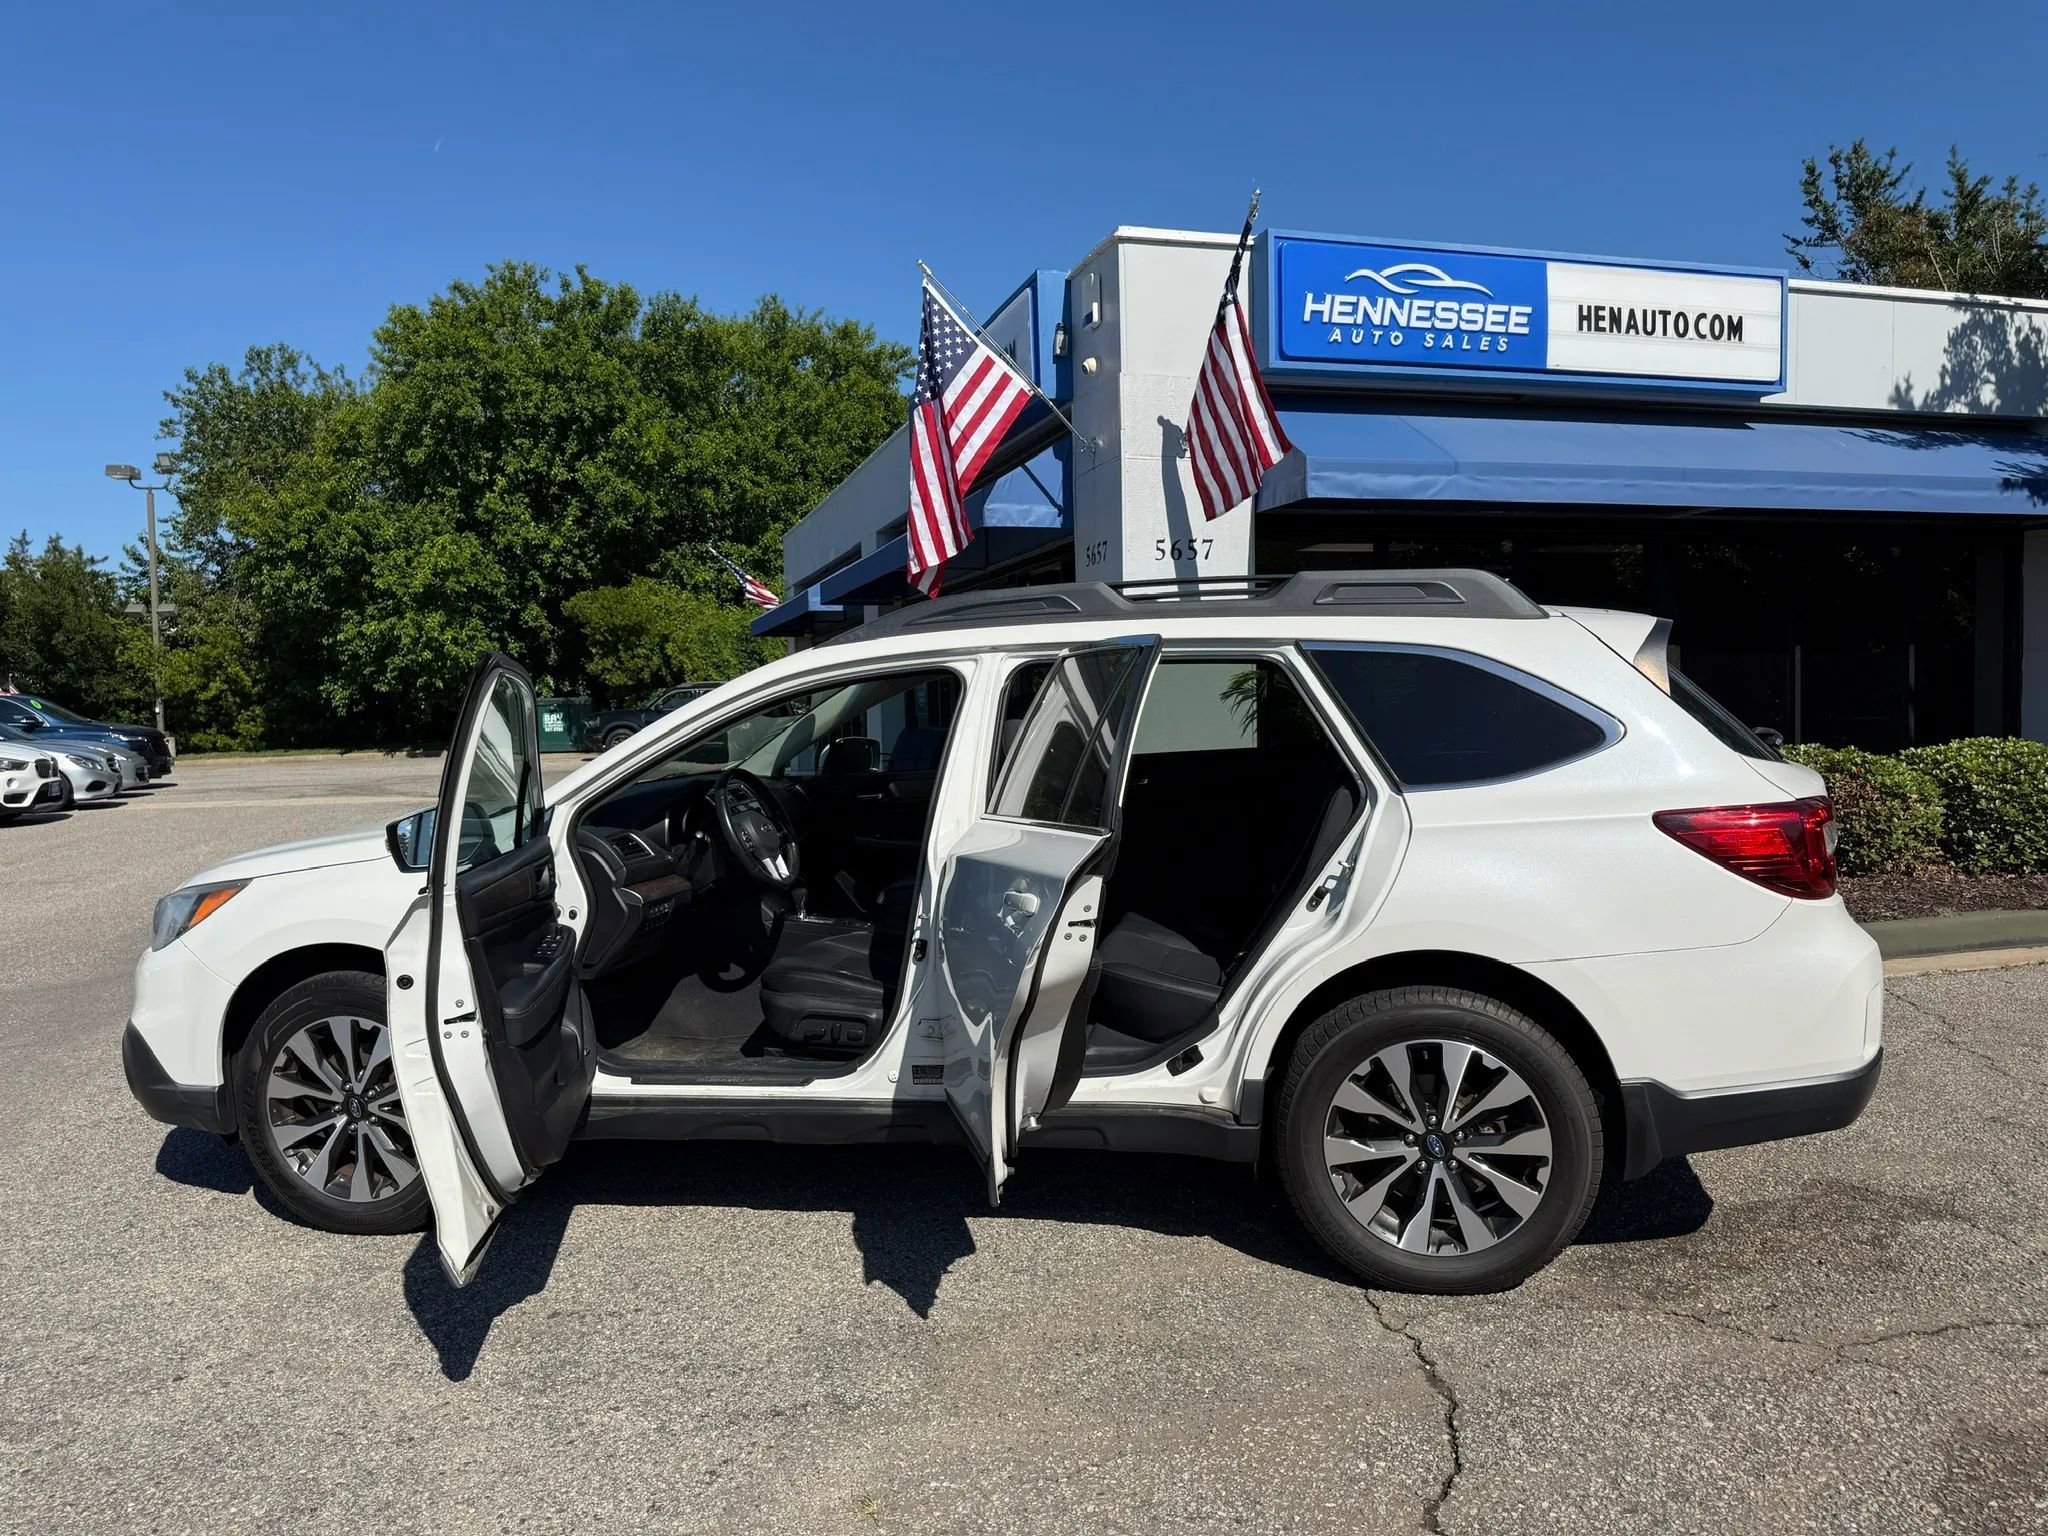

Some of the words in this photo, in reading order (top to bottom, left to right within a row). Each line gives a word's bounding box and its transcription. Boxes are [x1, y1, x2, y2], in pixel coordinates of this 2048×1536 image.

[1303, 292, 1533, 334] HENNESSEE
[1328, 327, 1404, 346] AUTO
[1424, 331, 1509, 352] SALES
[1086, 540, 1108, 567] 5657
[1154, 538, 1214, 561] 5657
